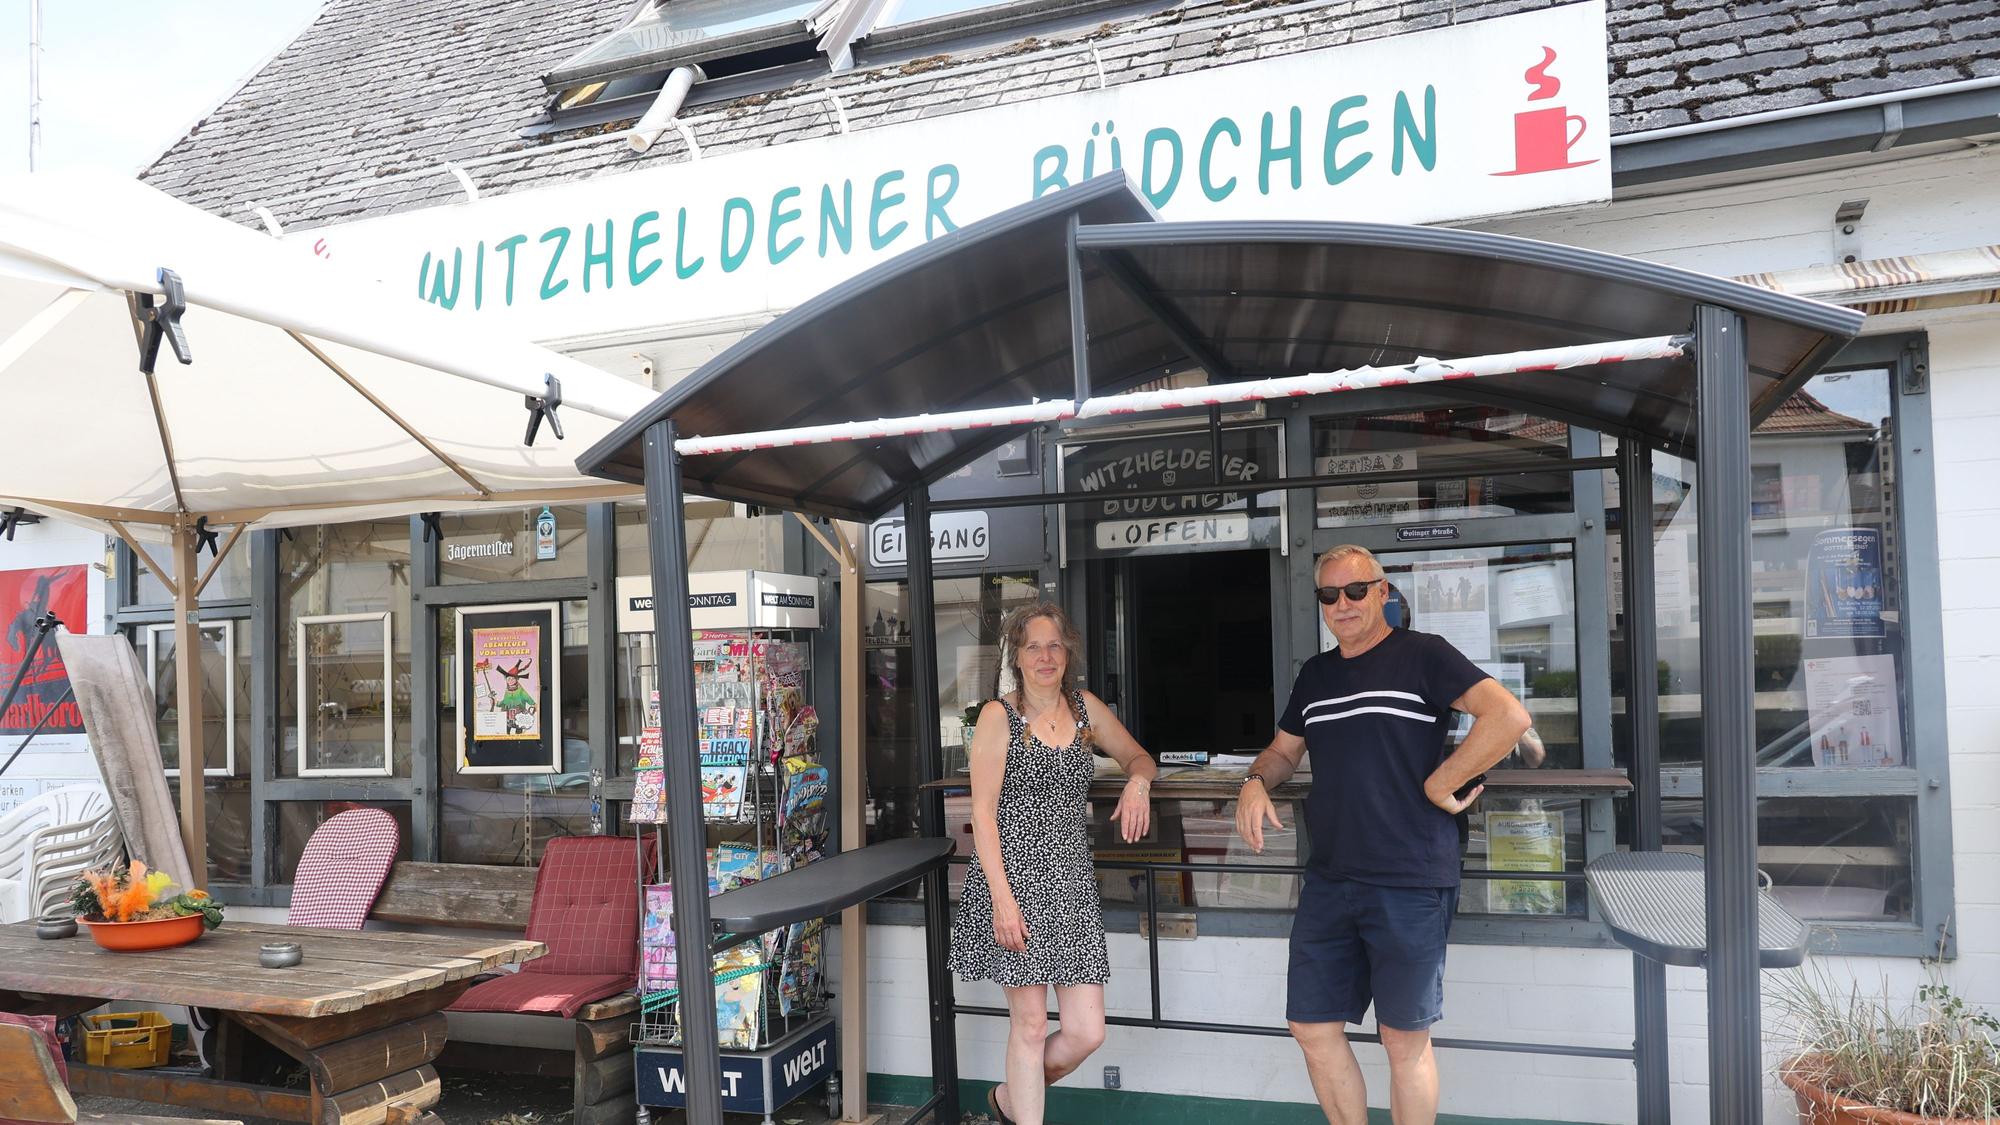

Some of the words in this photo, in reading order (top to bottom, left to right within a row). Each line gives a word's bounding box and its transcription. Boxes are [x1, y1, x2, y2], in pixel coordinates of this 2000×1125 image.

[418, 163, 961, 311] WITZHELDENER
[1032, 84, 1437, 210] BÜDCHEN
[880, 526, 986, 554] EIANG
[1125, 519, 1218, 544] OFFEN
[1402, 529, 1430, 538] Solinger
[1432, 528, 1454, 536] Straße
[690, 594, 732, 607] ONNTAG
[639, 743, 660, 755] Frau
[711, 740, 747, 755] LEGACY
[657, 1066, 743, 1097] WT
